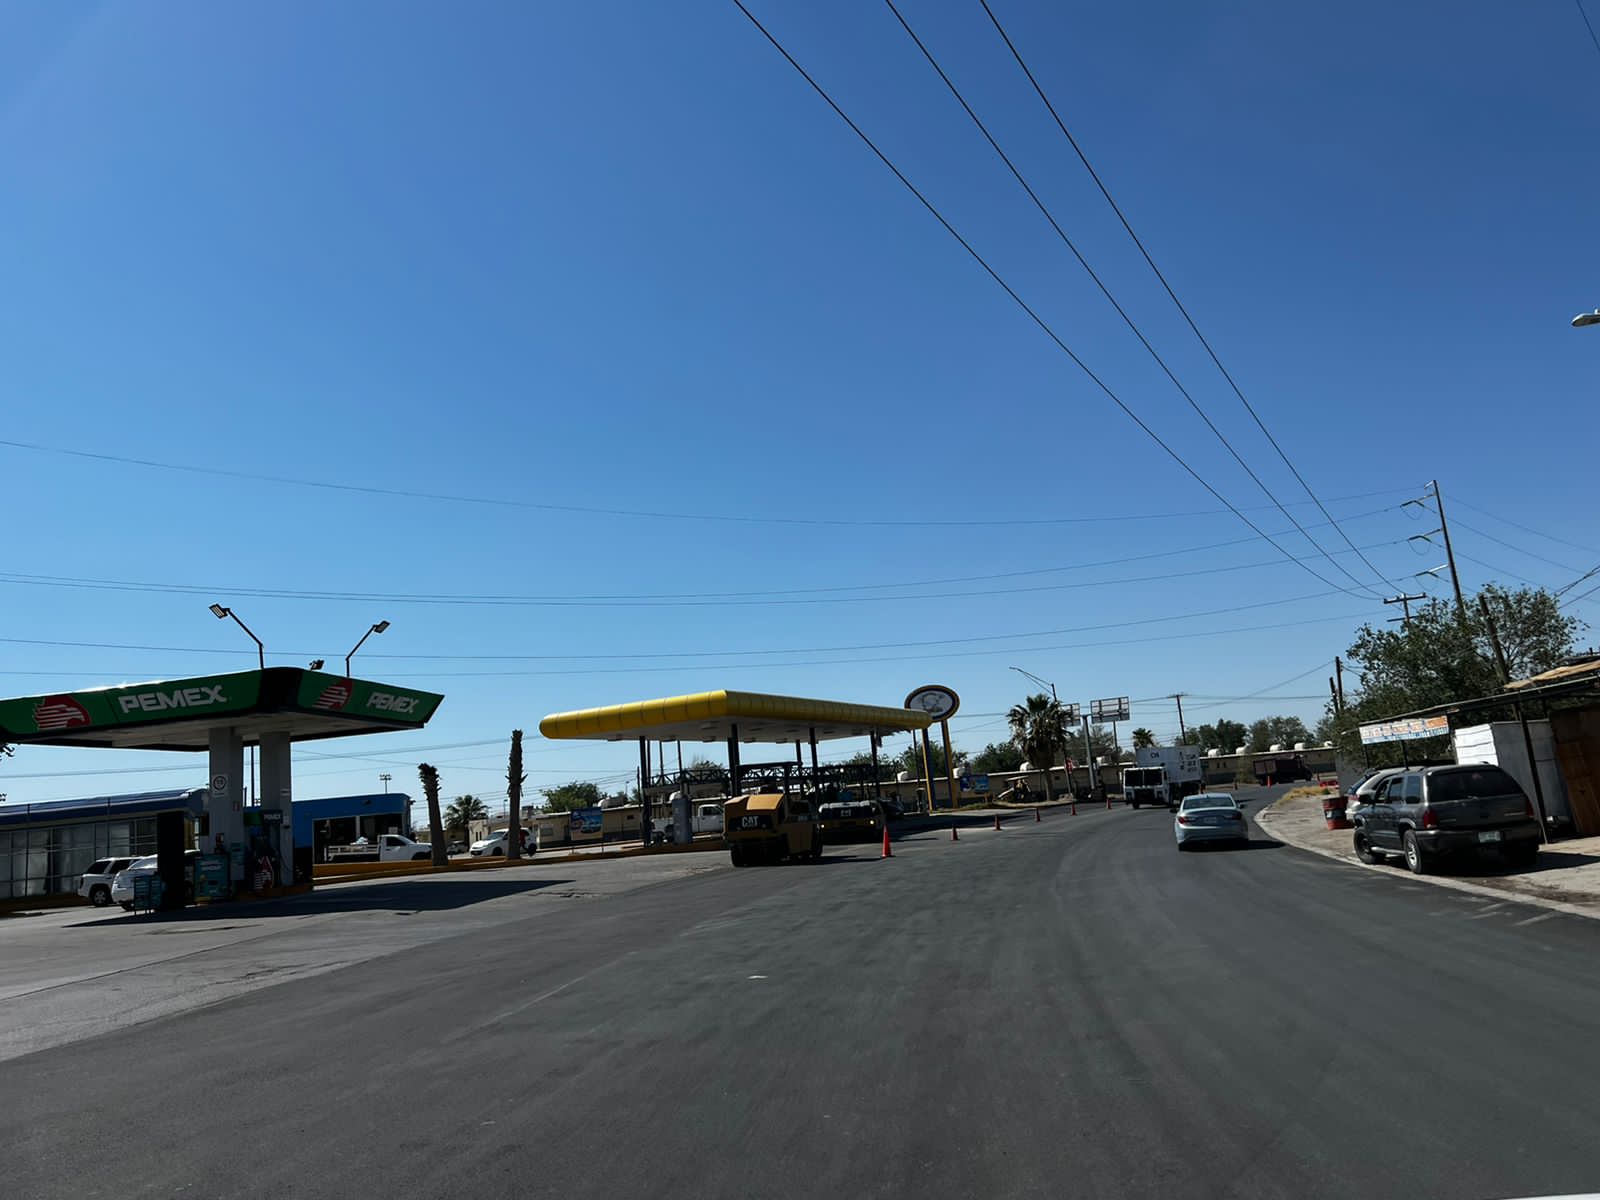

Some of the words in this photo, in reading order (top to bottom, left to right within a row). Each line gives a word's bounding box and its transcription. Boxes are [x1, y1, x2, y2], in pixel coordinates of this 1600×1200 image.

[118, 684, 227, 714] PEMEX
[366, 692, 419, 714] PEMEX
[741, 815, 759, 828] CAT
